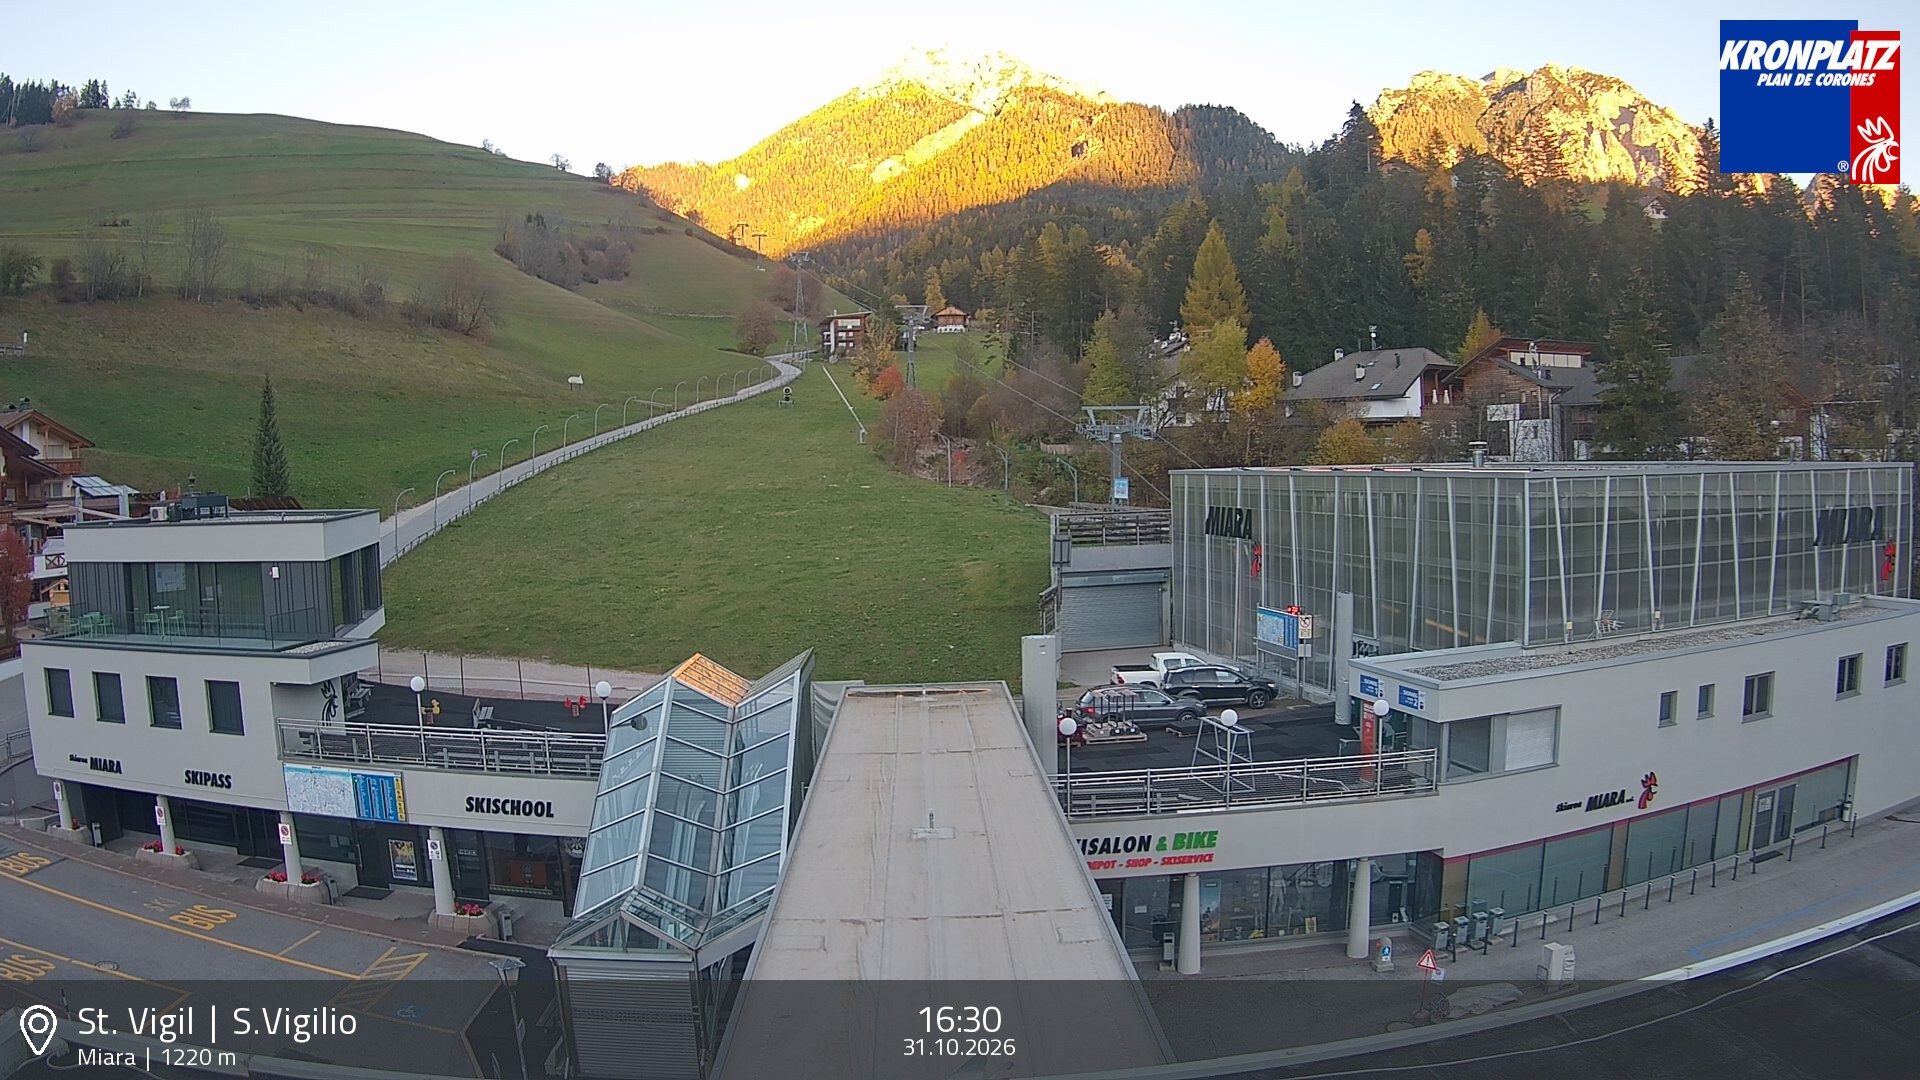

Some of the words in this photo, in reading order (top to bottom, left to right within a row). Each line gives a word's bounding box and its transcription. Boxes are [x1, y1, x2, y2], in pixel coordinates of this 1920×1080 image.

[1205, 506, 1253, 540] MIARA
[1813, 506, 1884, 547] MIARA
[90, 757, 122, 774] MIARA
[184, 769, 232, 789] SKIPASS
[465, 796, 554, 818] SKISCHOOL
[1585, 789, 1626, 812] MIARA
[1076, 834, 1152, 856] ISALON
[1156, 836, 1168, 852] &
[1172, 830, 1219, 851] BIKE
[0, 852, 50, 874] BUS
[1125, 857, 1152, 868] SHOP
[1160, 853, 1214, 866] SKISERVICE
[169, 904, 238, 931] BUS
